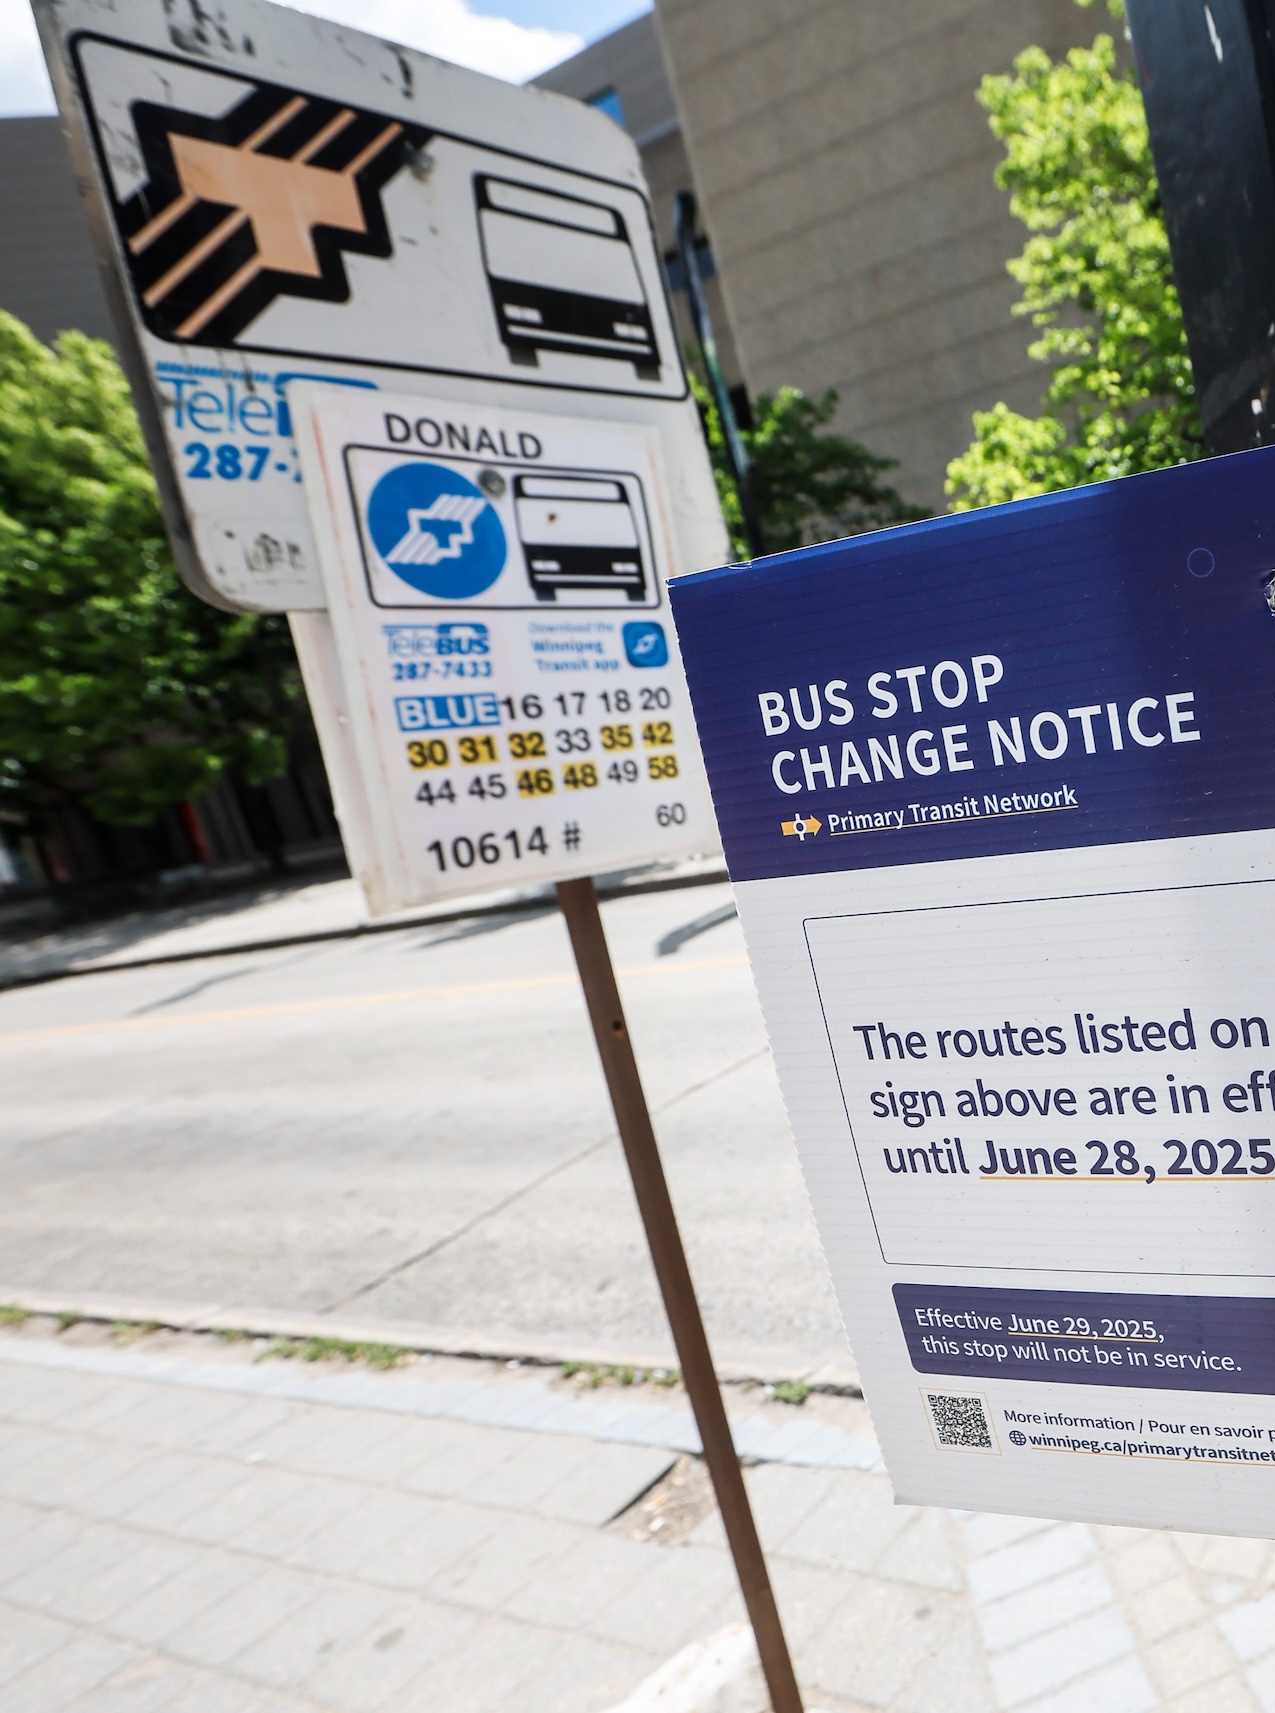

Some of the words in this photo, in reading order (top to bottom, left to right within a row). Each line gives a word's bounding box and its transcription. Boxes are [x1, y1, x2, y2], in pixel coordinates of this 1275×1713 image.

[384, 412, 542, 459] DONALD
[393, 662, 492, 680] 287-7433
[537, 659, 589, 672] Transit
[595, 661, 619, 671] app
[401, 695, 498, 728] BLUE
[502, 695, 543, 720] 16
[556, 692, 585, 716] 17
[600, 690, 631, 712] 18
[641, 688, 670, 710] 20
[758, 679, 854, 736] BUS
[867, 654, 1004, 719] STOP
[408, 740, 448, 767] 30
[458, 737, 497, 763] 31
[509, 732, 545, 758] 32
[556, 730, 591, 752] 33
[601, 726, 633, 749] 35
[642, 722, 673, 745] 42
[771, 724, 974, 795] CHANGE
[987, 691, 1200, 767] NOTICE
[416, 780, 455, 805] 44
[469, 774, 507, 798] 45
[518, 769, 553, 793] 46
[564, 764, 597, 787] 48
[607, 761, 638, 783] 49
[649, 756, 678, 779] 58
[656, 804, 685, 825] 60
[828, 807, 904, 833] Primary
[909, 797, 978, 823] Transit
[984, 785, 1077, 815] Network
[428, 827, 548, 871] 10614
[853, 1022, 927, 1061] The
[938, 1021, 1066, 1059] routes
[1074, 1008, 1197, 1055] listed
[1210, 1014, 1269, 1050] on
[870, 1081, 947, 1128] sign
[955, 1079, 1077, 1118] above
[1090, 1087, 1156, 1115] are
[1167, 1075, 1210, 1114] in
[883, 1138, 969, 1174] until
[979, 1140, 1077, 1176] June
[1085, 1141, 1157, 1184] 28,
[915, 1308, 1002, 1331] Effective
[1008, 1313, 1060, 1335] June
[1063, 1317, 1098, 1338] 29,
[1100, 1319, 1164, 1343] 2025,
[922, 1336, 959, 1355] this
[963, 1339, 1007, 1362] stop
[1012, 1342, 1049, 1362] will
[1054, 1345, 1091, 1364] not
[1095, 1345, 1122, 1365] be
[1127, 1348, 1148, 1366] in
[1154, 1352, 1242, 1372] service.
[1003, 1409, 1041, 1424] More
[1045, 1412, 1135, 1431] information
[1148, 1420, 1186, 1435] Pour
[1190, 1424, 1210, 1435] en
[1214, 1425, 1264, 1438] savoir
